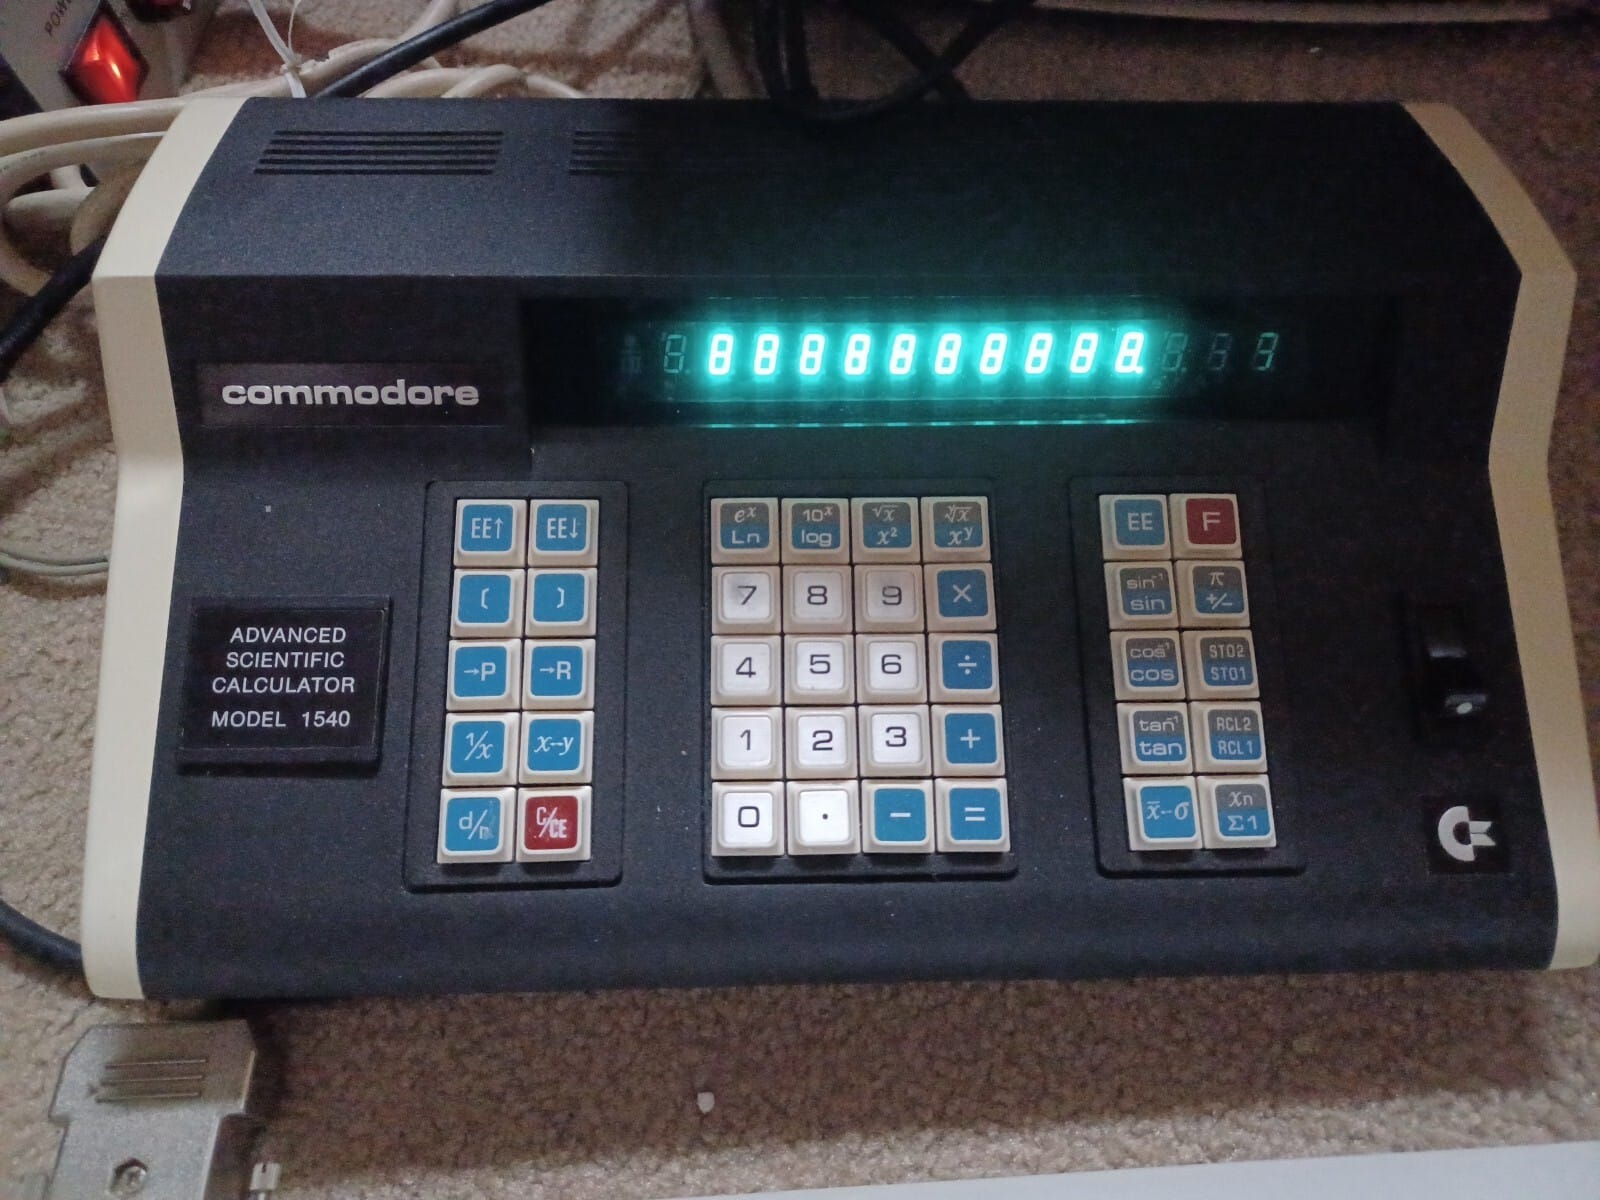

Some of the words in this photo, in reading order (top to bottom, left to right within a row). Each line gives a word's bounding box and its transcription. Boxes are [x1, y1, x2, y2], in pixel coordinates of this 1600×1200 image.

[221, 379, 480, 406] commodore
[1127, 512, 1153, 531] EE
[1202, 511, 1221, 532] F
[731, 530, 760, 544] Ln
[801, 529, 832, 545] log
[737, 585, 757, 605] 7
[807, 585, 828, 606] 8
[882, 585, 902, 606] 9
[1130, 595, 1166, 611] sin
[229, 627, 346, 644] ADVANCED
[225, 651, 345, 669] SCIENTIFIC
[735, 656, 756, 679] 4
[809, 654, 831, 675] 5
[881, 654, 902, 675] 6
[211, 676, 355, 694] CALCULATOR
[1130, 668, 1175, 682] cos
[211, 710, 287, 728] MODEL
[301, 710, 351, 728] 1540
[740, 729, 752, 751] 1
[812, 730, 833, 751] 2
[885, 726, 907, 748] 3
[1138, 740, 1183, 756] tan
[737, 805, 760, 828] 0
